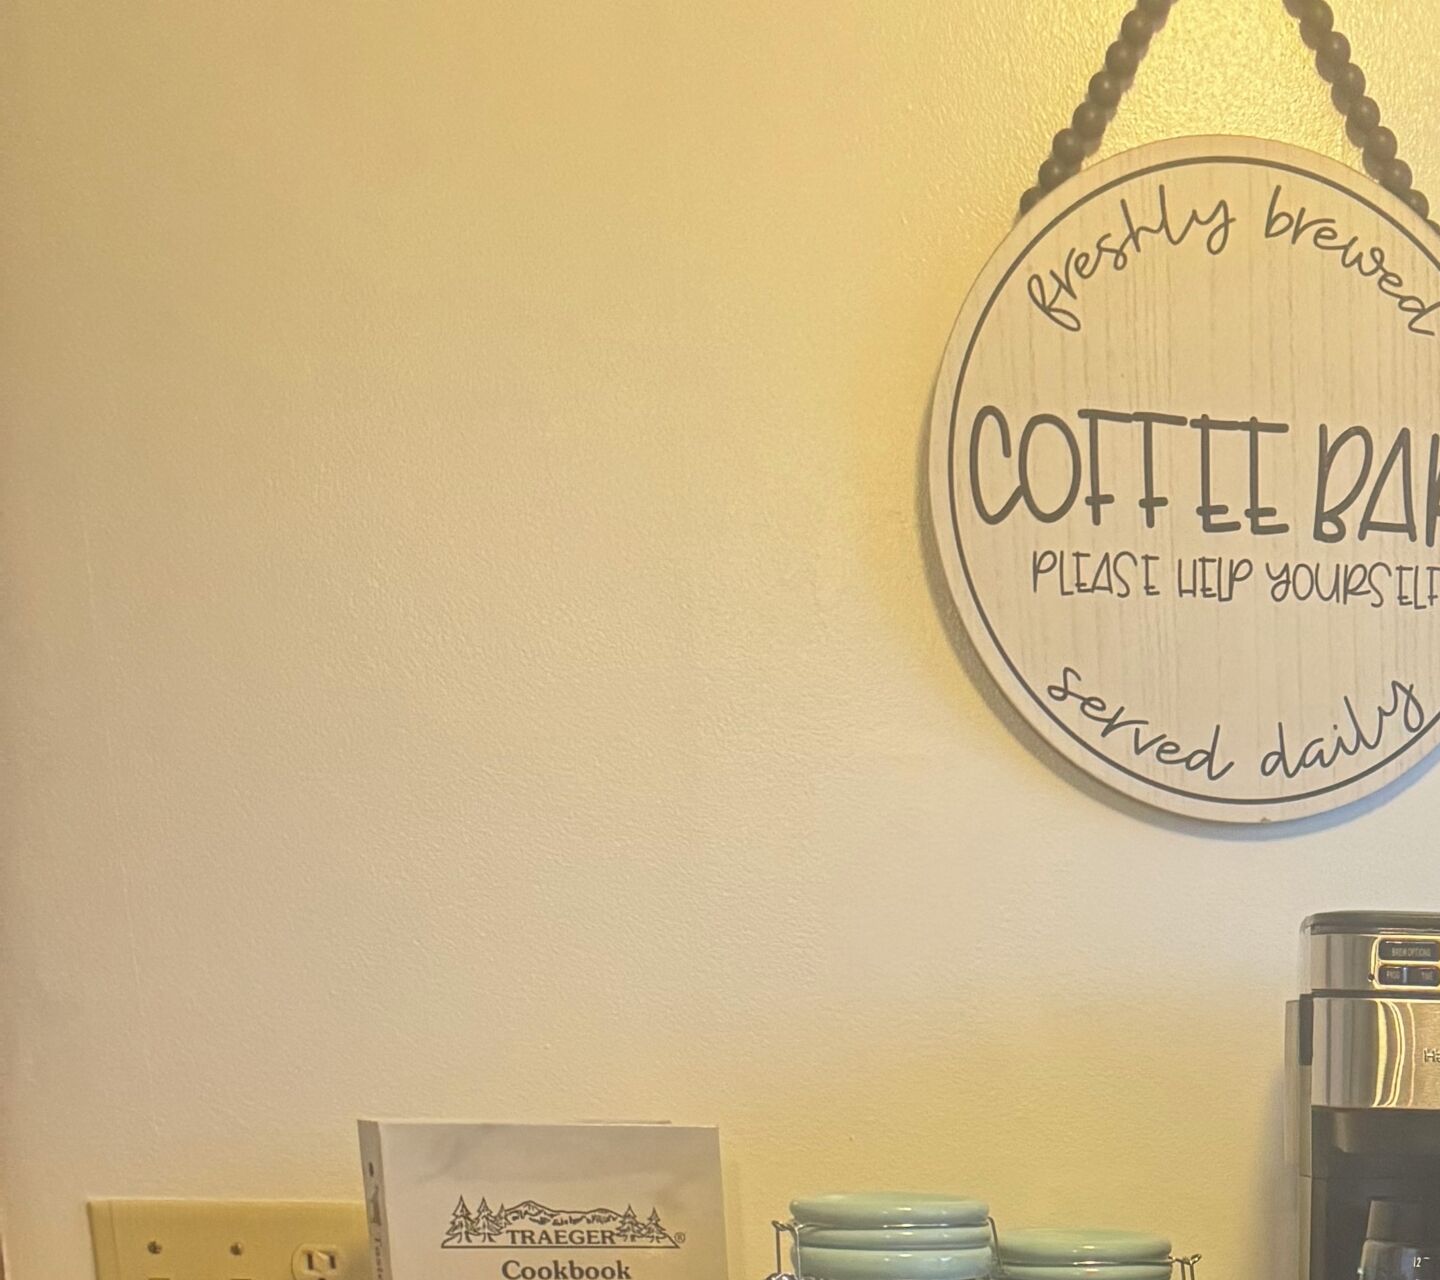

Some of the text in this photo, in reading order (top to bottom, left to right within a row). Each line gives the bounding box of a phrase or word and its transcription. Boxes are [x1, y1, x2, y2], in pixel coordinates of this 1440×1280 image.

[1027, 184, 1237, 332] freshly
[969, 404, 1290, 535] COFFEE
[1032, 550, 1161, 598] PLEASE
[1178, 556, 1253, 602] HELP
[1046, 666, 1427, 782] served daily
[506, 1229, 616, 1245] TRAEGER
[1413, 1256, 1422, 1269] 12
[501, 1259, 632, 1280] Cookbook
